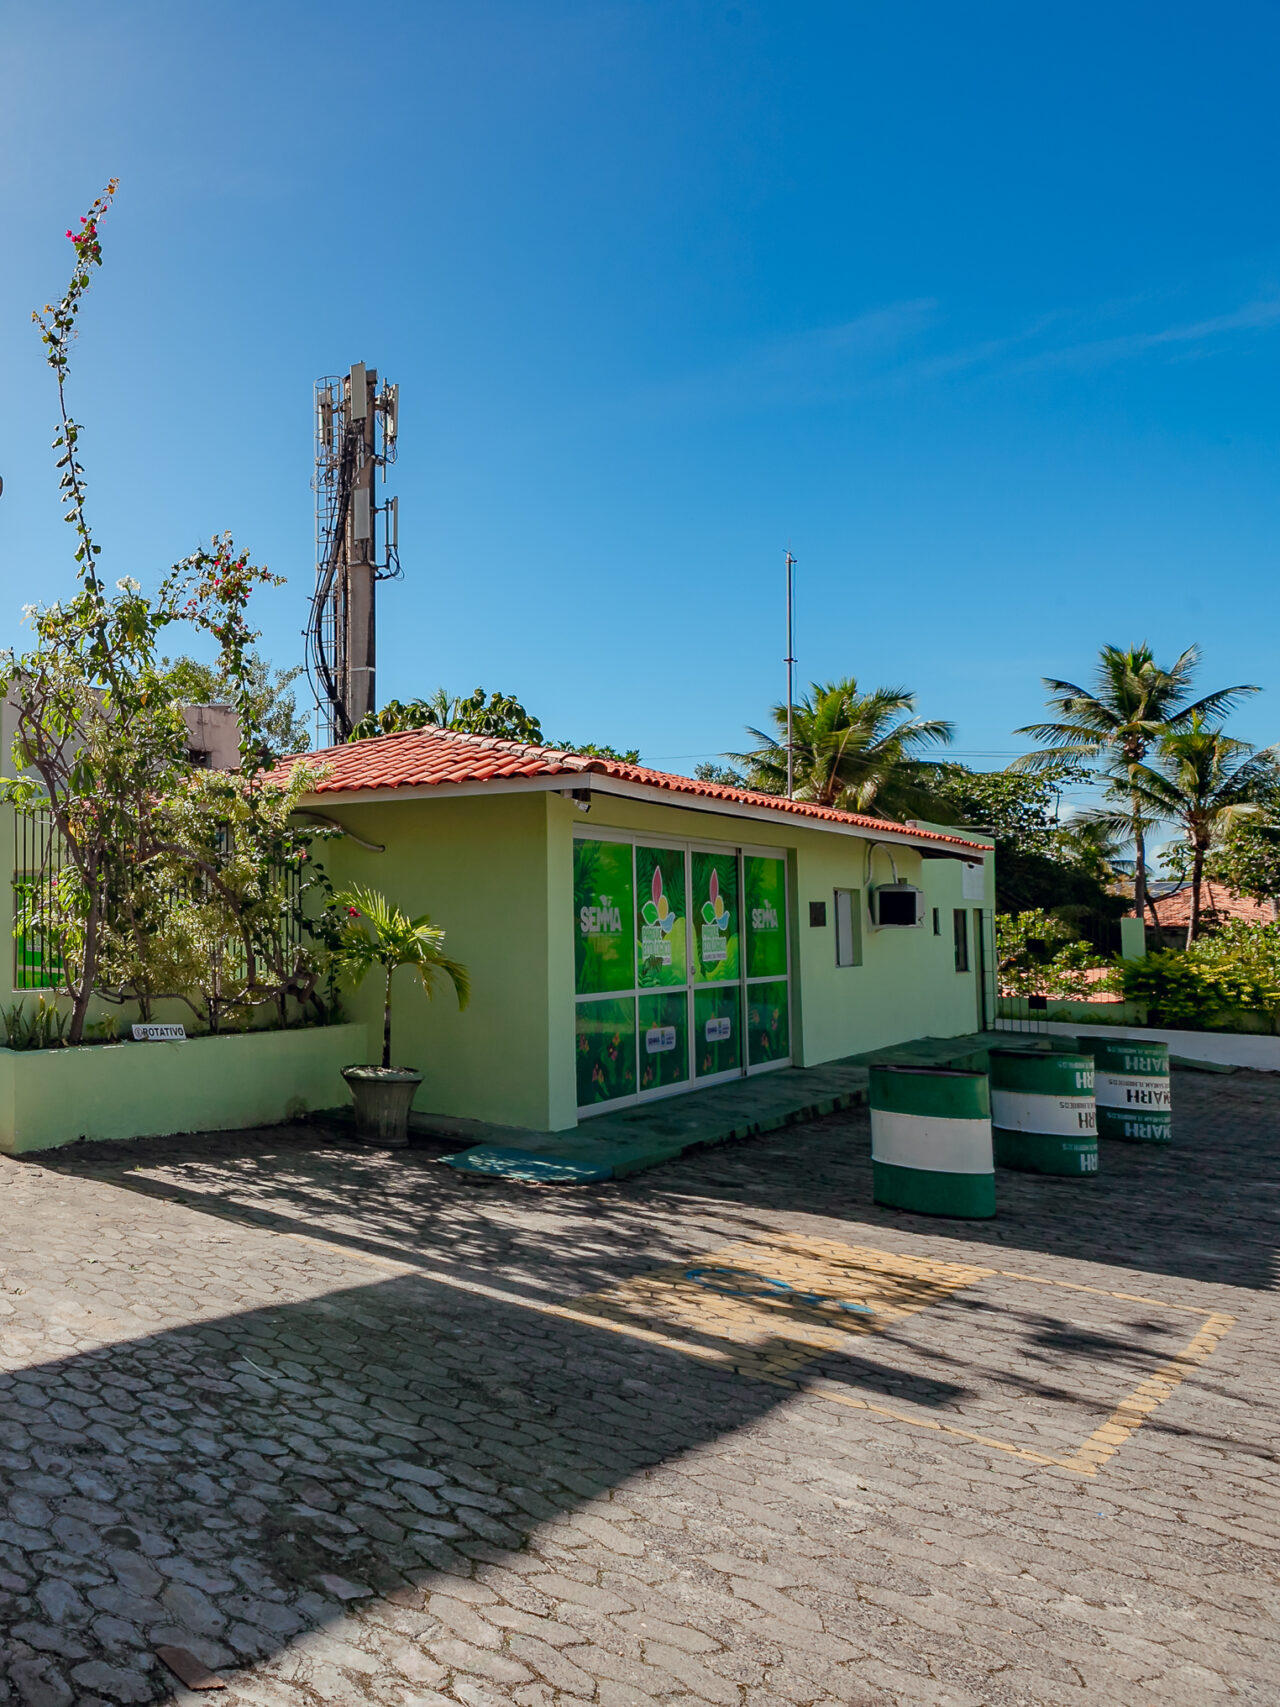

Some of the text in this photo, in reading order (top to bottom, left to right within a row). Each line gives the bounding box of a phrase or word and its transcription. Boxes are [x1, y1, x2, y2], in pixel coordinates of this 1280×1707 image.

[580, 905, 622, 932] SEMMA
[752, 908, 779, 929] SEMMA
[142, 1027, 184, 1037] ROTATIVO
